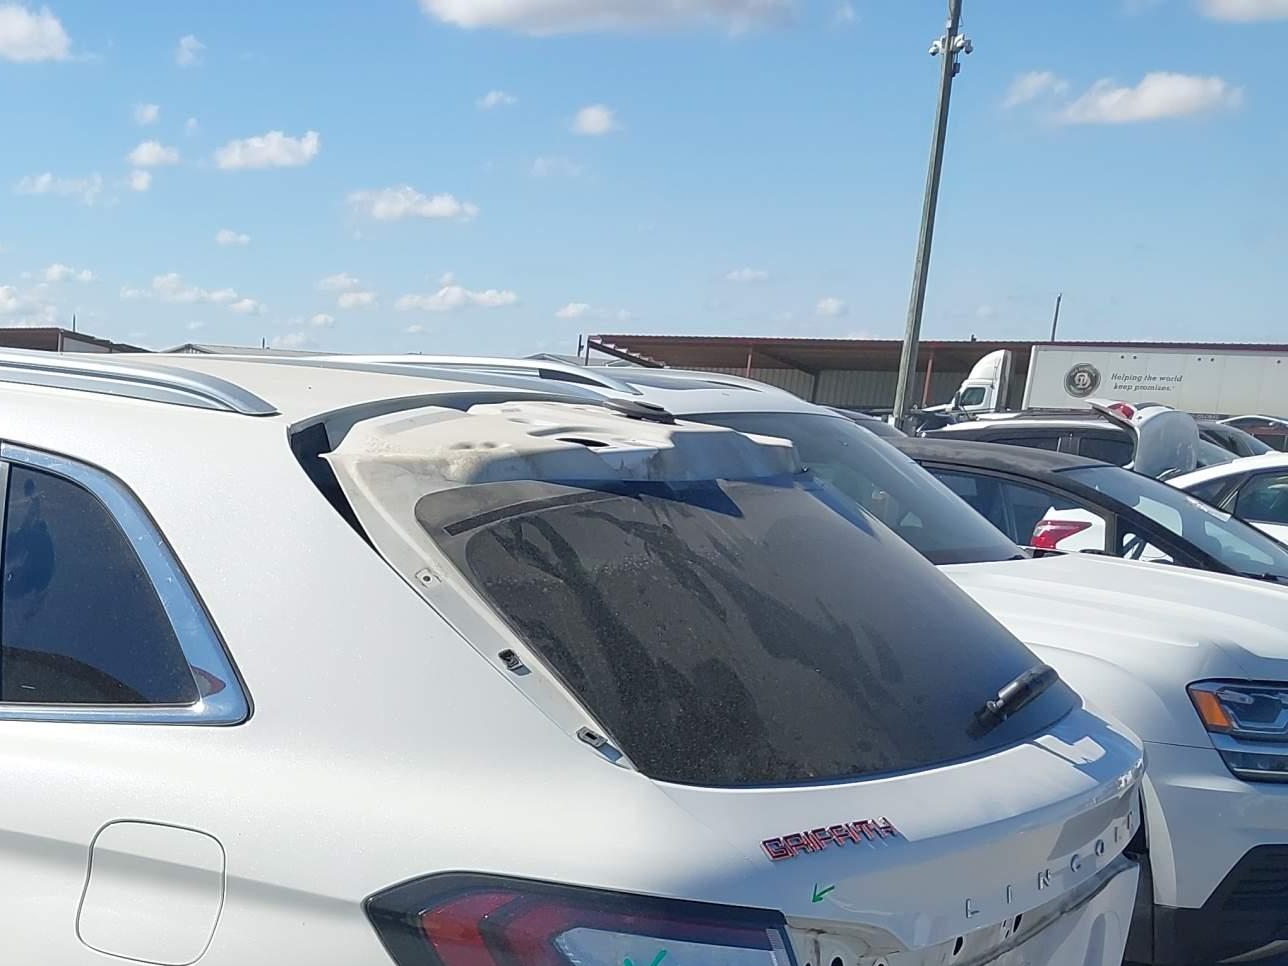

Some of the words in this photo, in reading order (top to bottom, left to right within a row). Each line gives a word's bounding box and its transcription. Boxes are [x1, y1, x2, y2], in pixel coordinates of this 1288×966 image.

[1111, 373, 1143, 383] Helping
[1144, 373, 1157, 382] the
[1159, 374, 1183, 382] world
[1113, 382, 1133, 392] keep
[760, 816, 897, 860] GRIFFITH
